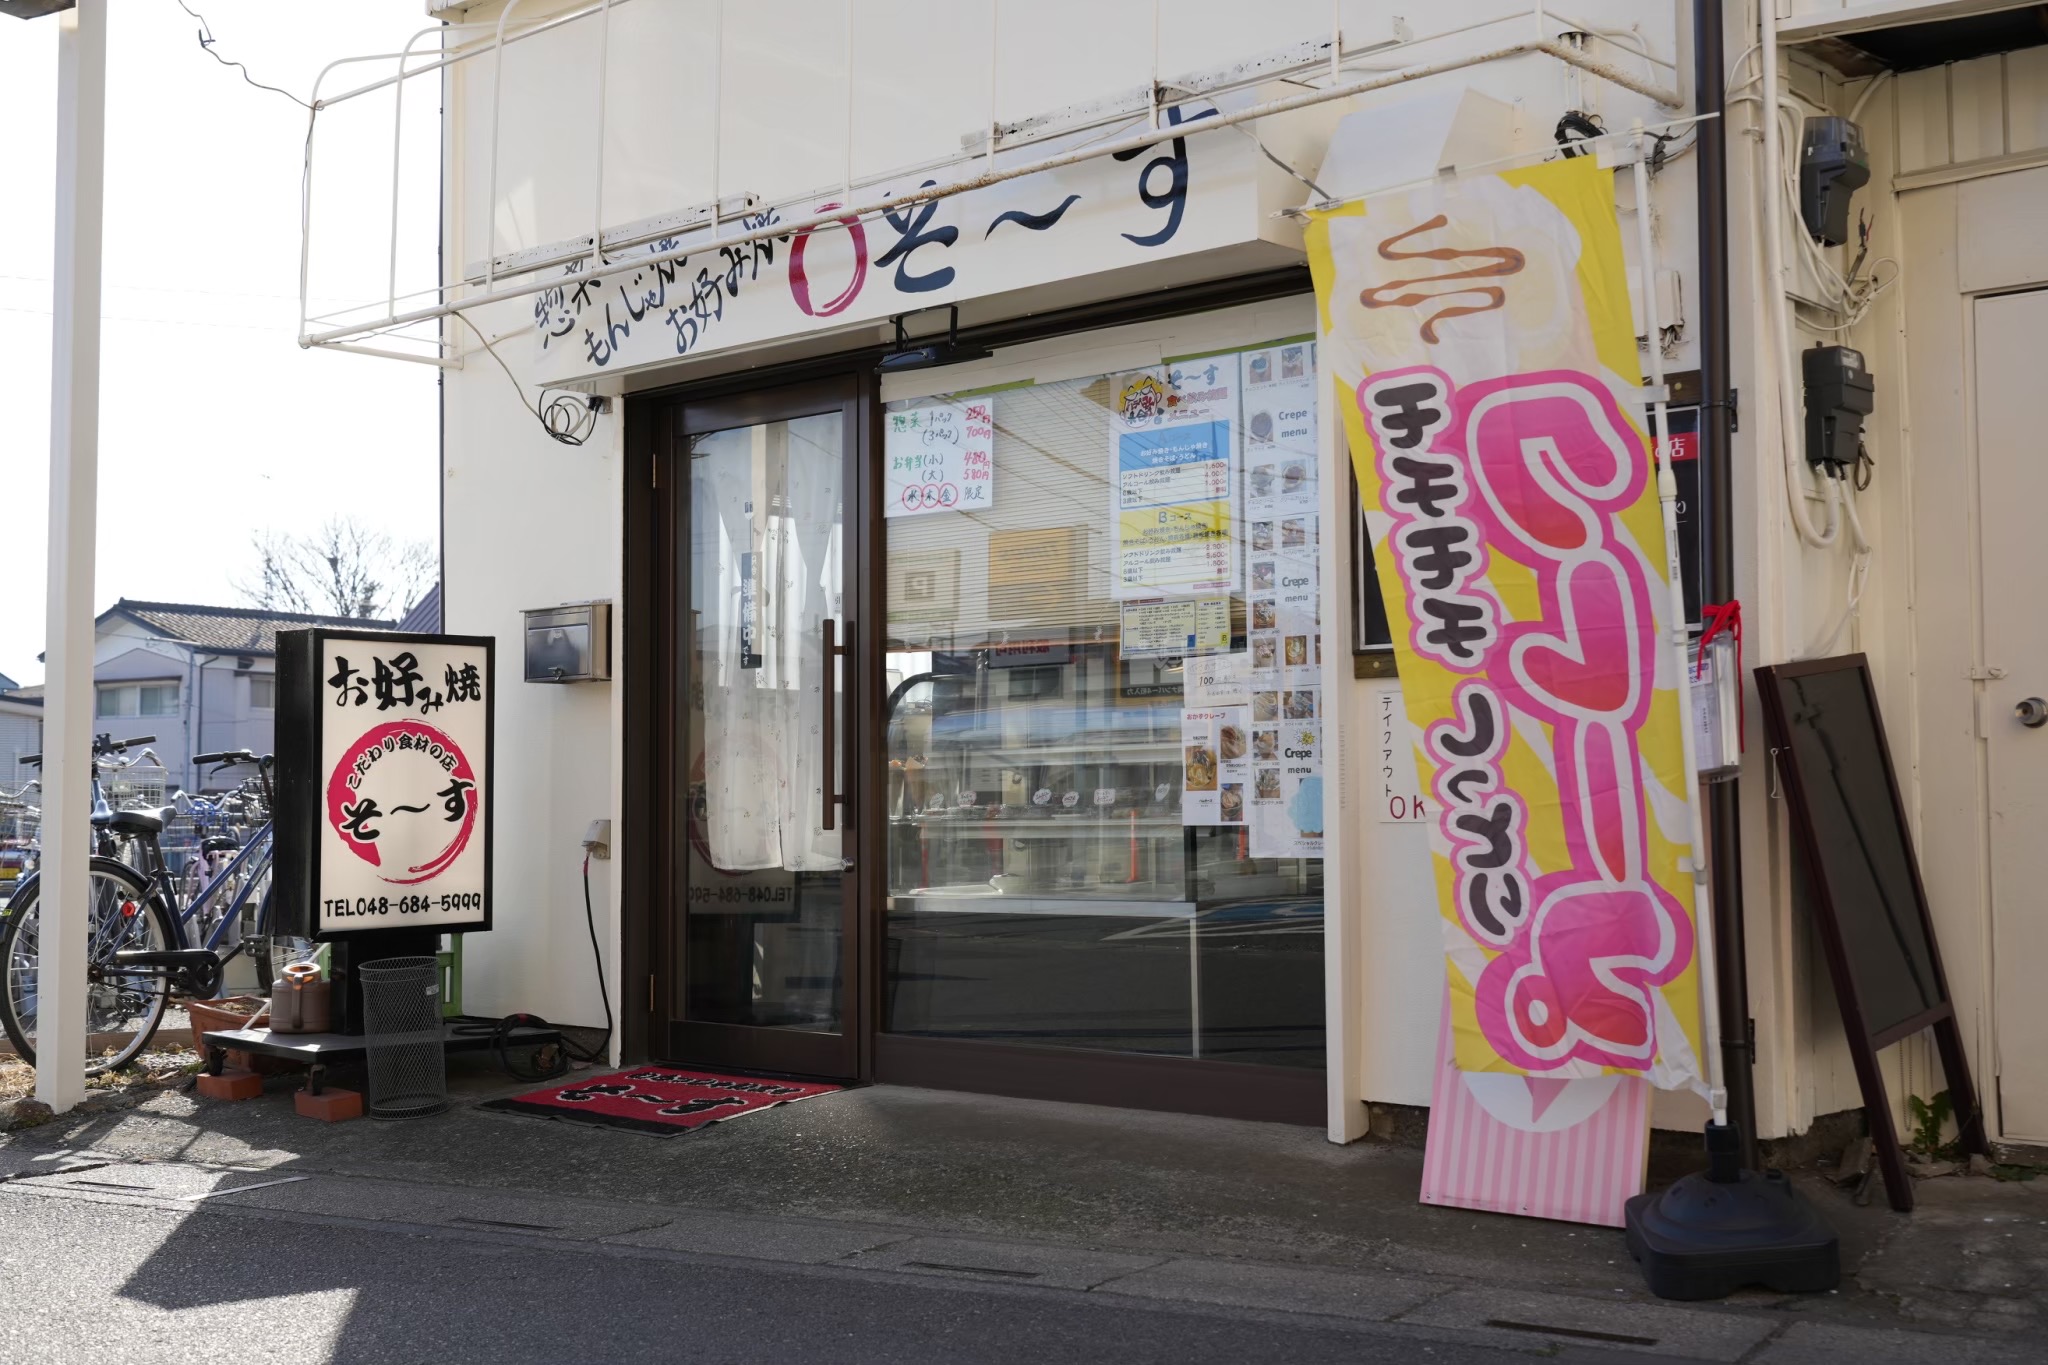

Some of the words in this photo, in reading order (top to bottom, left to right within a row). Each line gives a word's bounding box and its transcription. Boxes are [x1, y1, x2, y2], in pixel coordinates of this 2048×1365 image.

[893, 411, 922, 432] 惣菜
[965, 405, 991, 424] 250円
[1278, 409, 1308, 421] Crepe
[966, 425, 991, 439] 700円
[1281, 428, 1308, 438] menu
[964, 485, 985, 501] 限定
[1158, 511, 1167, 524] B
[1281, 576, 1309, 588] Crepe
[1285, 595, 1309, 603] menu
[327, 652, 481, 714] お好み焼
[1284, 747, 1312, 760] Crepe
[346, 733, 457, 789] こだわり食材の店
[1390, 794, 1426, 821] OK
[324, 892, 481, 918] TEL048-684-5999
